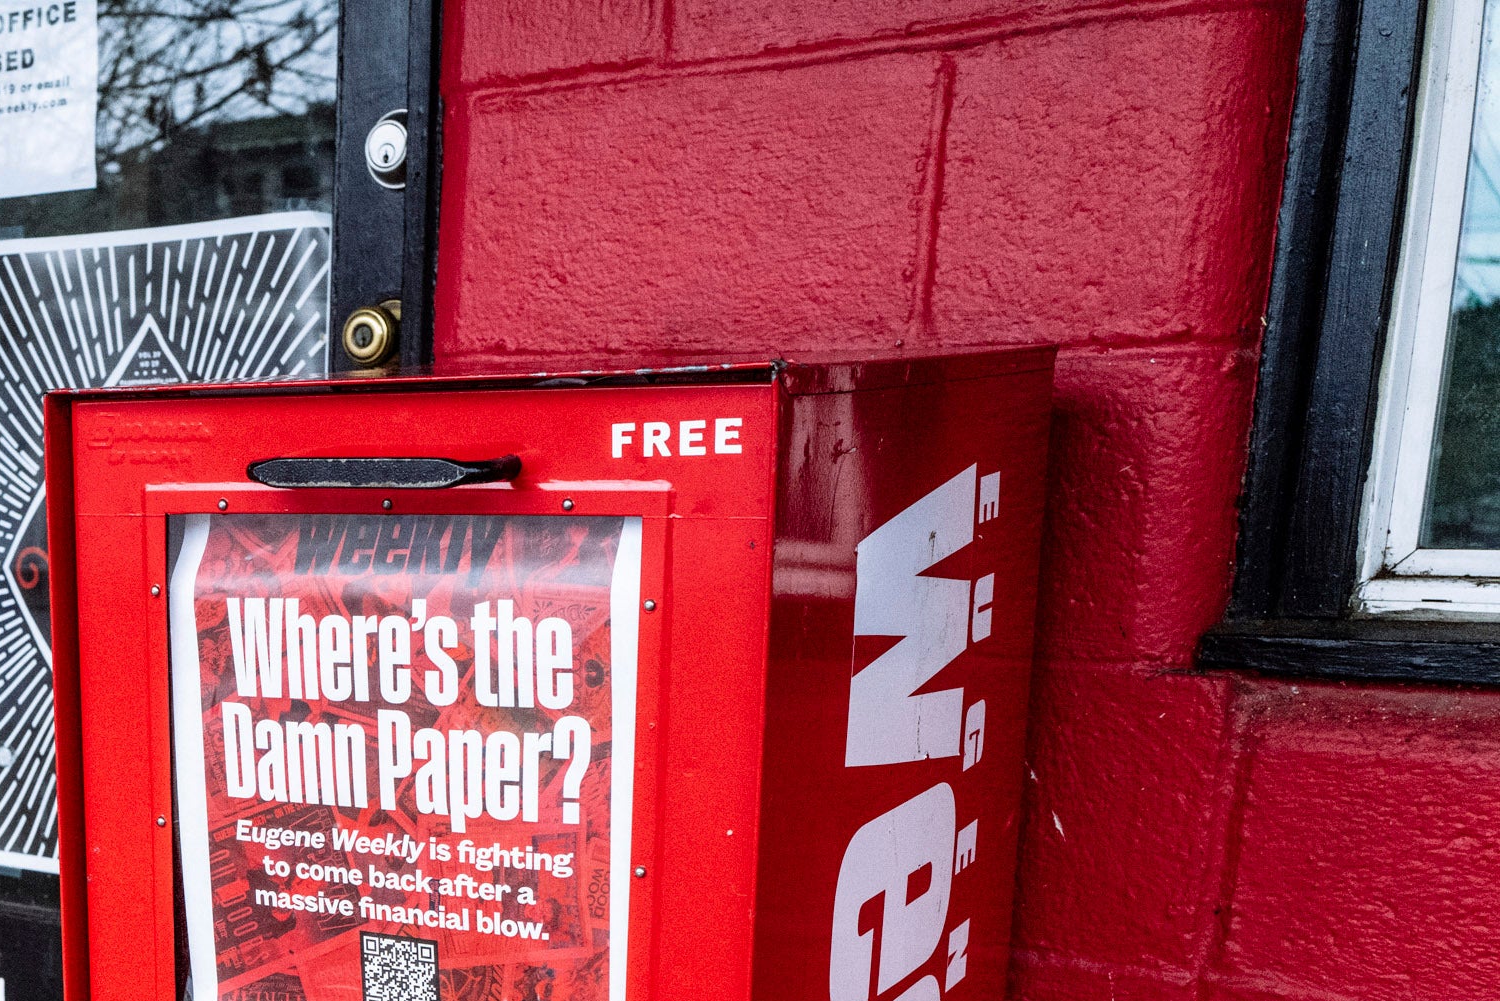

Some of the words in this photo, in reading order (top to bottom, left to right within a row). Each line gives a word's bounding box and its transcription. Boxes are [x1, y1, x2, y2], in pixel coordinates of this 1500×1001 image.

[20, 82, 33, 92] or
[37, 75, 71, 91] email
[610, 417, 744, 458] FREE
[470, 599, 574, 710] the
[221, 701, 369, 810] Damn
[377, 708, 592, 834] Paper?
[235, 819, 326, 850] Eugene
[331, 828, 426, 863] Weekly
[429, 837, 451, 862] is
[457, 839, 575, 878] fighting
[262, 854, 291, 878] to
[295, 861, 363, 887] come
[368, 866, 432, 894] back
[438, 873, 511, 902] after
[517, 885, 537, 906] a
[255, 886, 354, 917] massive
[358, 895, 470, 932] financial
[475, 908, 550, 941] blow.
